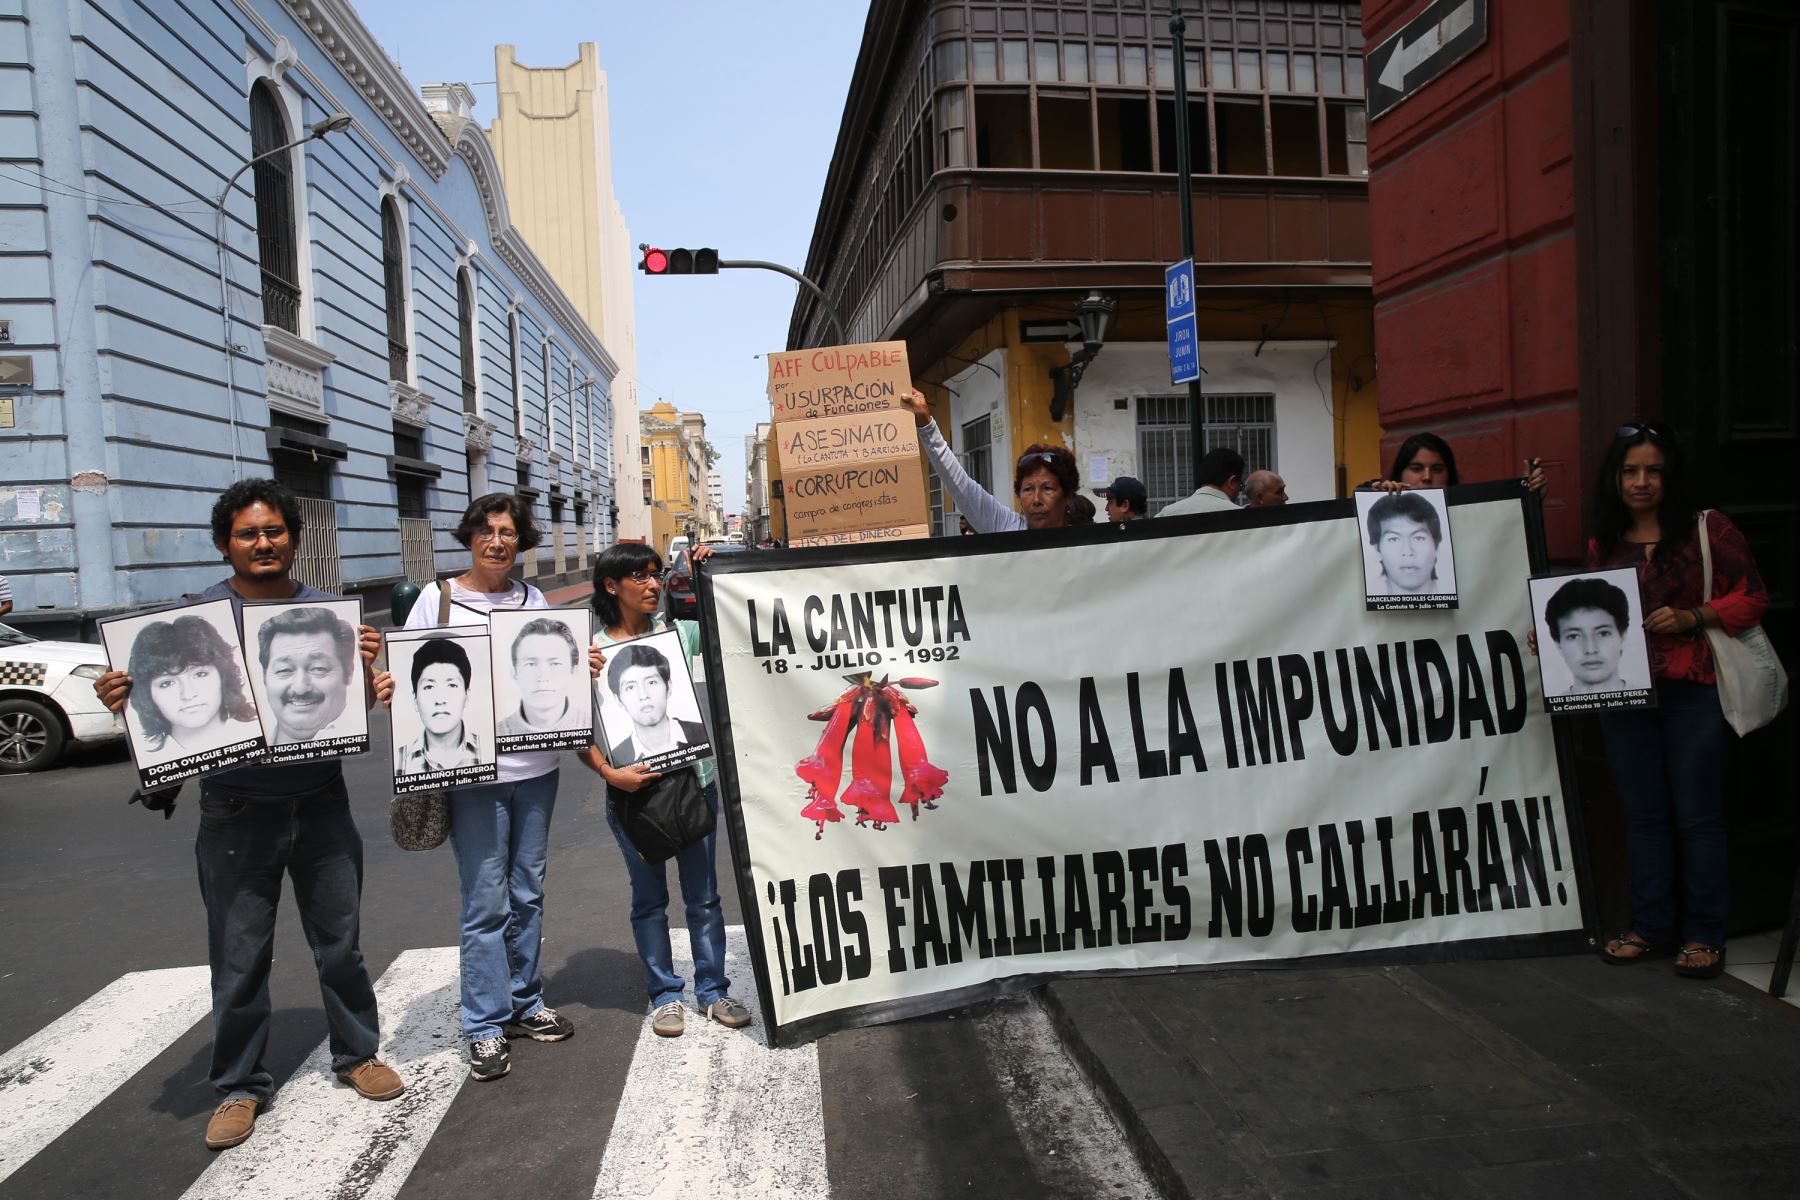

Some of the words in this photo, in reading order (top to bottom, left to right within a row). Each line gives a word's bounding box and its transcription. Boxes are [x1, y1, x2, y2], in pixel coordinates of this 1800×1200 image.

[773, 358, 802, 379] AFF
[812, 350, 902, 382] CULPABLE
[806, 408, 818, 418] de
[824, 400, 889, 416] Funciones
[790, 423, 897, 454] ASESINATO
[794, 509, 826, 522] compra
[829, 504, 839, 513] de
[843, 492, 897, 516] congresistas
[833, 533, 858, 544] DEL
[860, 529, 902, 541] DINERO
[746, 597, 797, 658] LA
[803, 584, 971, 654] CANTUTA
[761, 658, 789, 675] 18
[810, 651, 882, 671] JULIO
[904, 645, 960, 664] 1992
[1566, 694, 1599, 703] ENRIQUE
[1600, 691, 1622, 699] ORTIZ
[968, 680, 1058, 796] NO
[1079, 676, 1120, 786] A
[1126, 667, 1208, 780] LA
[1214, 629, 1528, 769] IMPUNIDAD
[274, 744, 299, 753] HUGO
[301, 740, 330, 750] MUÑOZ
[332, 736, 367, 746] SÁNCHEZ
[496, 735, 523, 743] ROBERT
[525, 732, 558, 741] TEODORO
[560, 730, 592, 738] ESPINOZA
[148, 761, 179, 776] DORA
[181, 749, 222, 766] OYAGUE
[224, 739, 258, 755] FIERRO
[273, 754, 304, 762] Cantuta
[668, 749, 687, 760] AMARO
[145, 779, 158, 788] La
[160, 768, 199, 783] Cantuta
[218, 756, 238, 767] Julio
[245, 748, 266, 759] 1992
[395, 775, 416, 784] JUAN
[419, 770, 454, 781] MARIÑOS
[456, 765, 495, 776] FIGUEROA
[409, 783, 440, 792] Cantuta
[878, 842, 1191, 974] FAMILIARES
[1203, 832, 1275, 939] NO
[1286, 766, 1568, 934] CALLARÁN!
